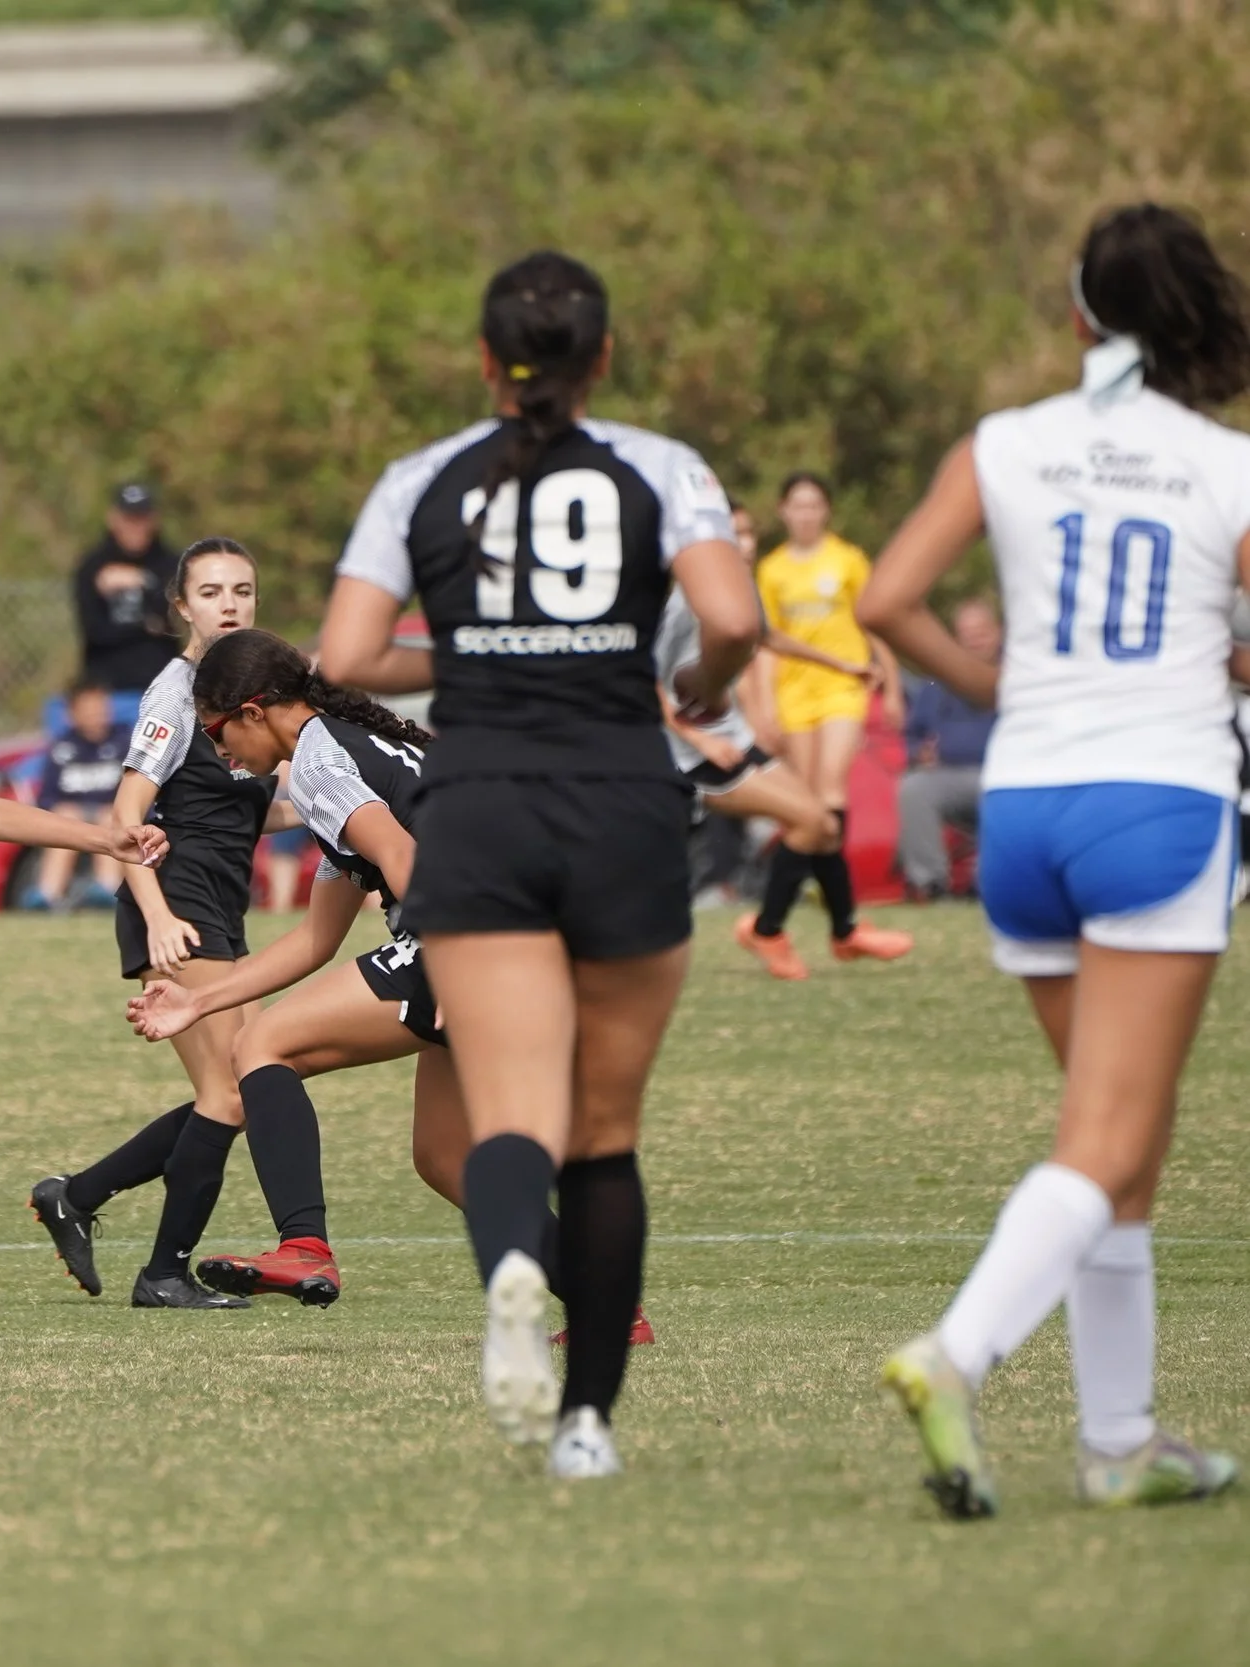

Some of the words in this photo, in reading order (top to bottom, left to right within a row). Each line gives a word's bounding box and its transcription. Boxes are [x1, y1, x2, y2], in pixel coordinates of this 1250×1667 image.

[461, 468, 622, 622] 19
[1054, 513, 1171, 658] 10
[143, 721, 169, 742] DP
